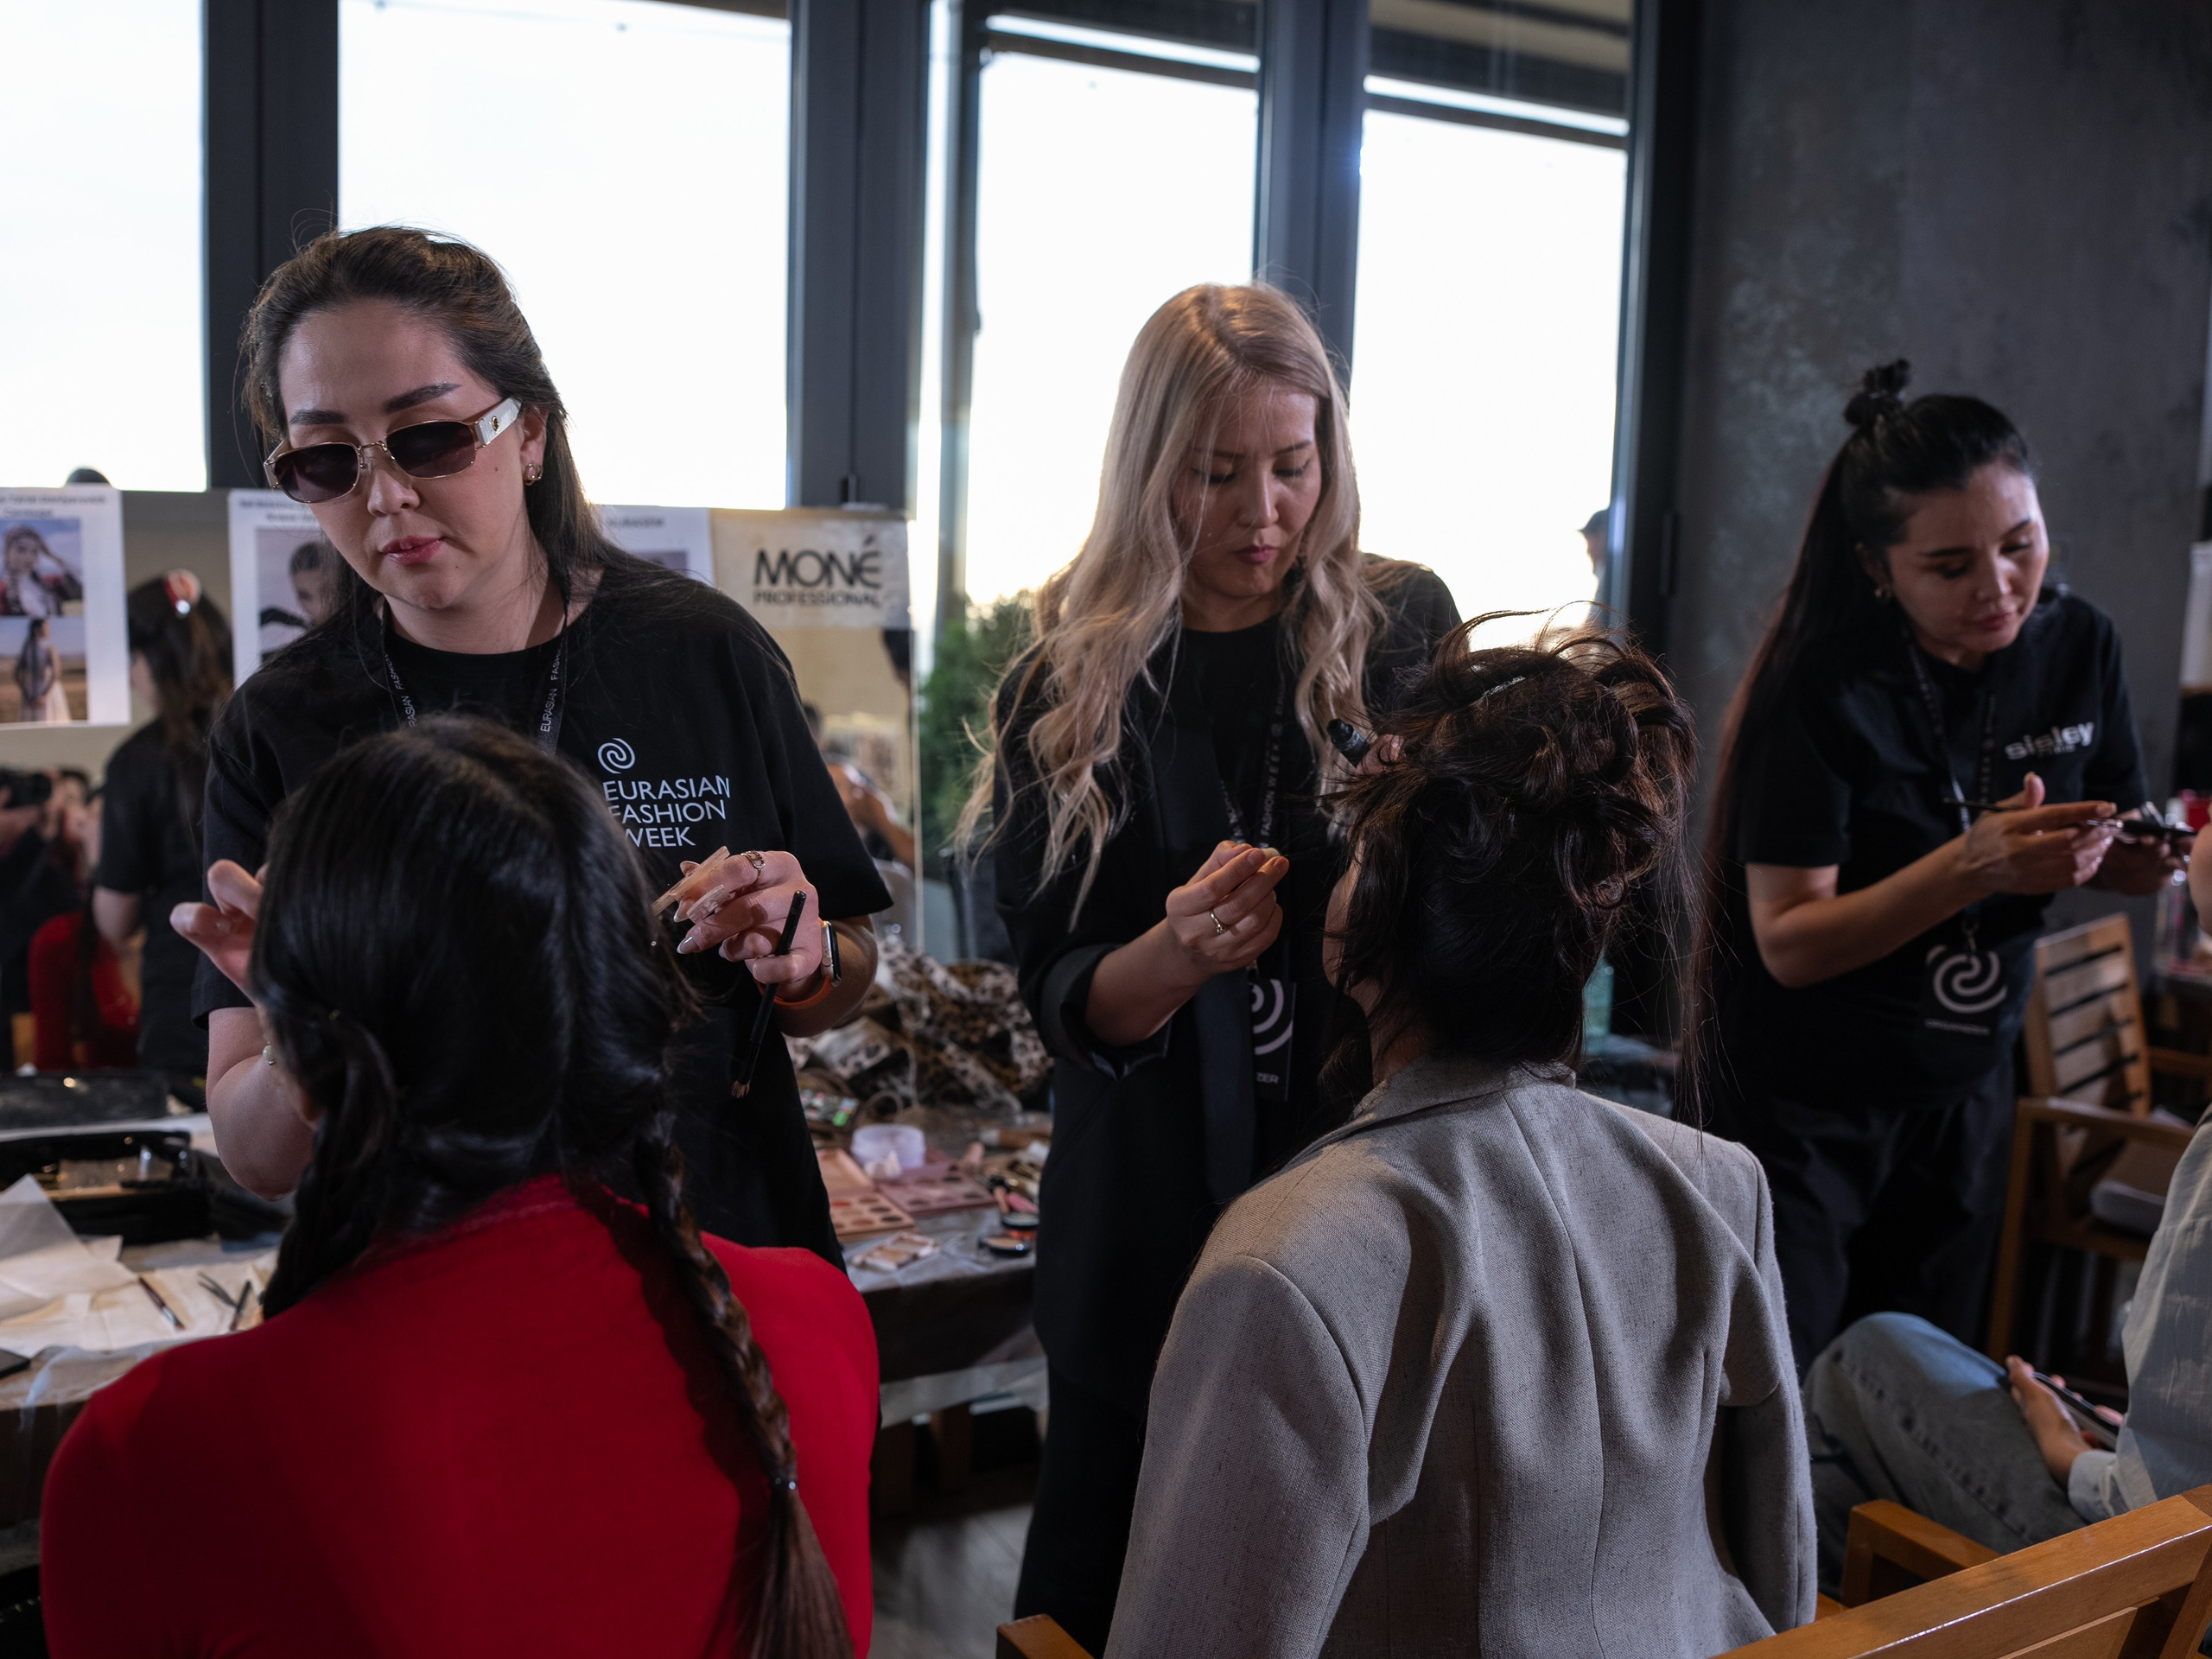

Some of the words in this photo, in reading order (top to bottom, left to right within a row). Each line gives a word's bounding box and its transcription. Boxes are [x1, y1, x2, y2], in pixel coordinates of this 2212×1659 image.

[754, 534, 881, 589] MONÉ
[753, 589, 880, 608] PROFESSIONAL
[401, 696, 416, 728] RASIAN
[540, 688, 557, 733] EURASIAN
[2005, 721, 2094, 760] sisley
[603, 775, 730, 801] EURASIAN
[607, 799, 727, 823] FASHION
